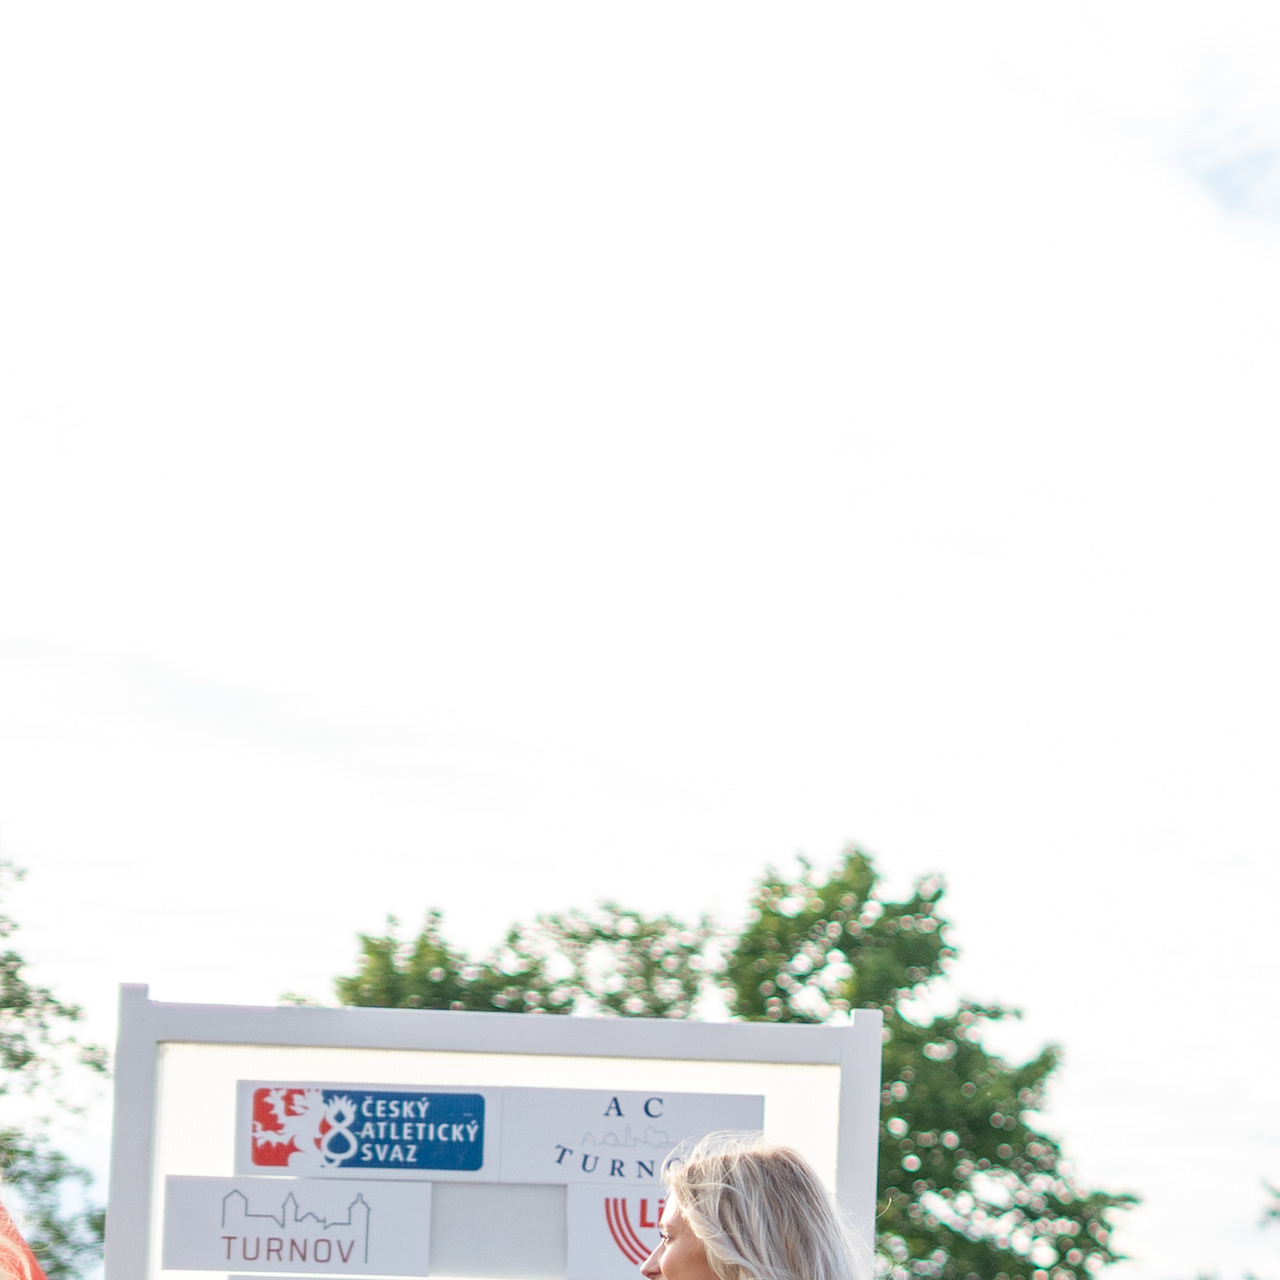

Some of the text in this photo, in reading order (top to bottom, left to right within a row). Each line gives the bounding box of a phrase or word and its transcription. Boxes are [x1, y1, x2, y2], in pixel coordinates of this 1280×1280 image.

[361, 1096, 430, 1119] ČESKÝ
[359, 1119, 479, 1143] ATLETICKÝ
[361, 1143, 418, 1163] SVAZ
[555, 1144, 685, 1179] TURN
[221, 1235, 355, 1264] TURNOV
